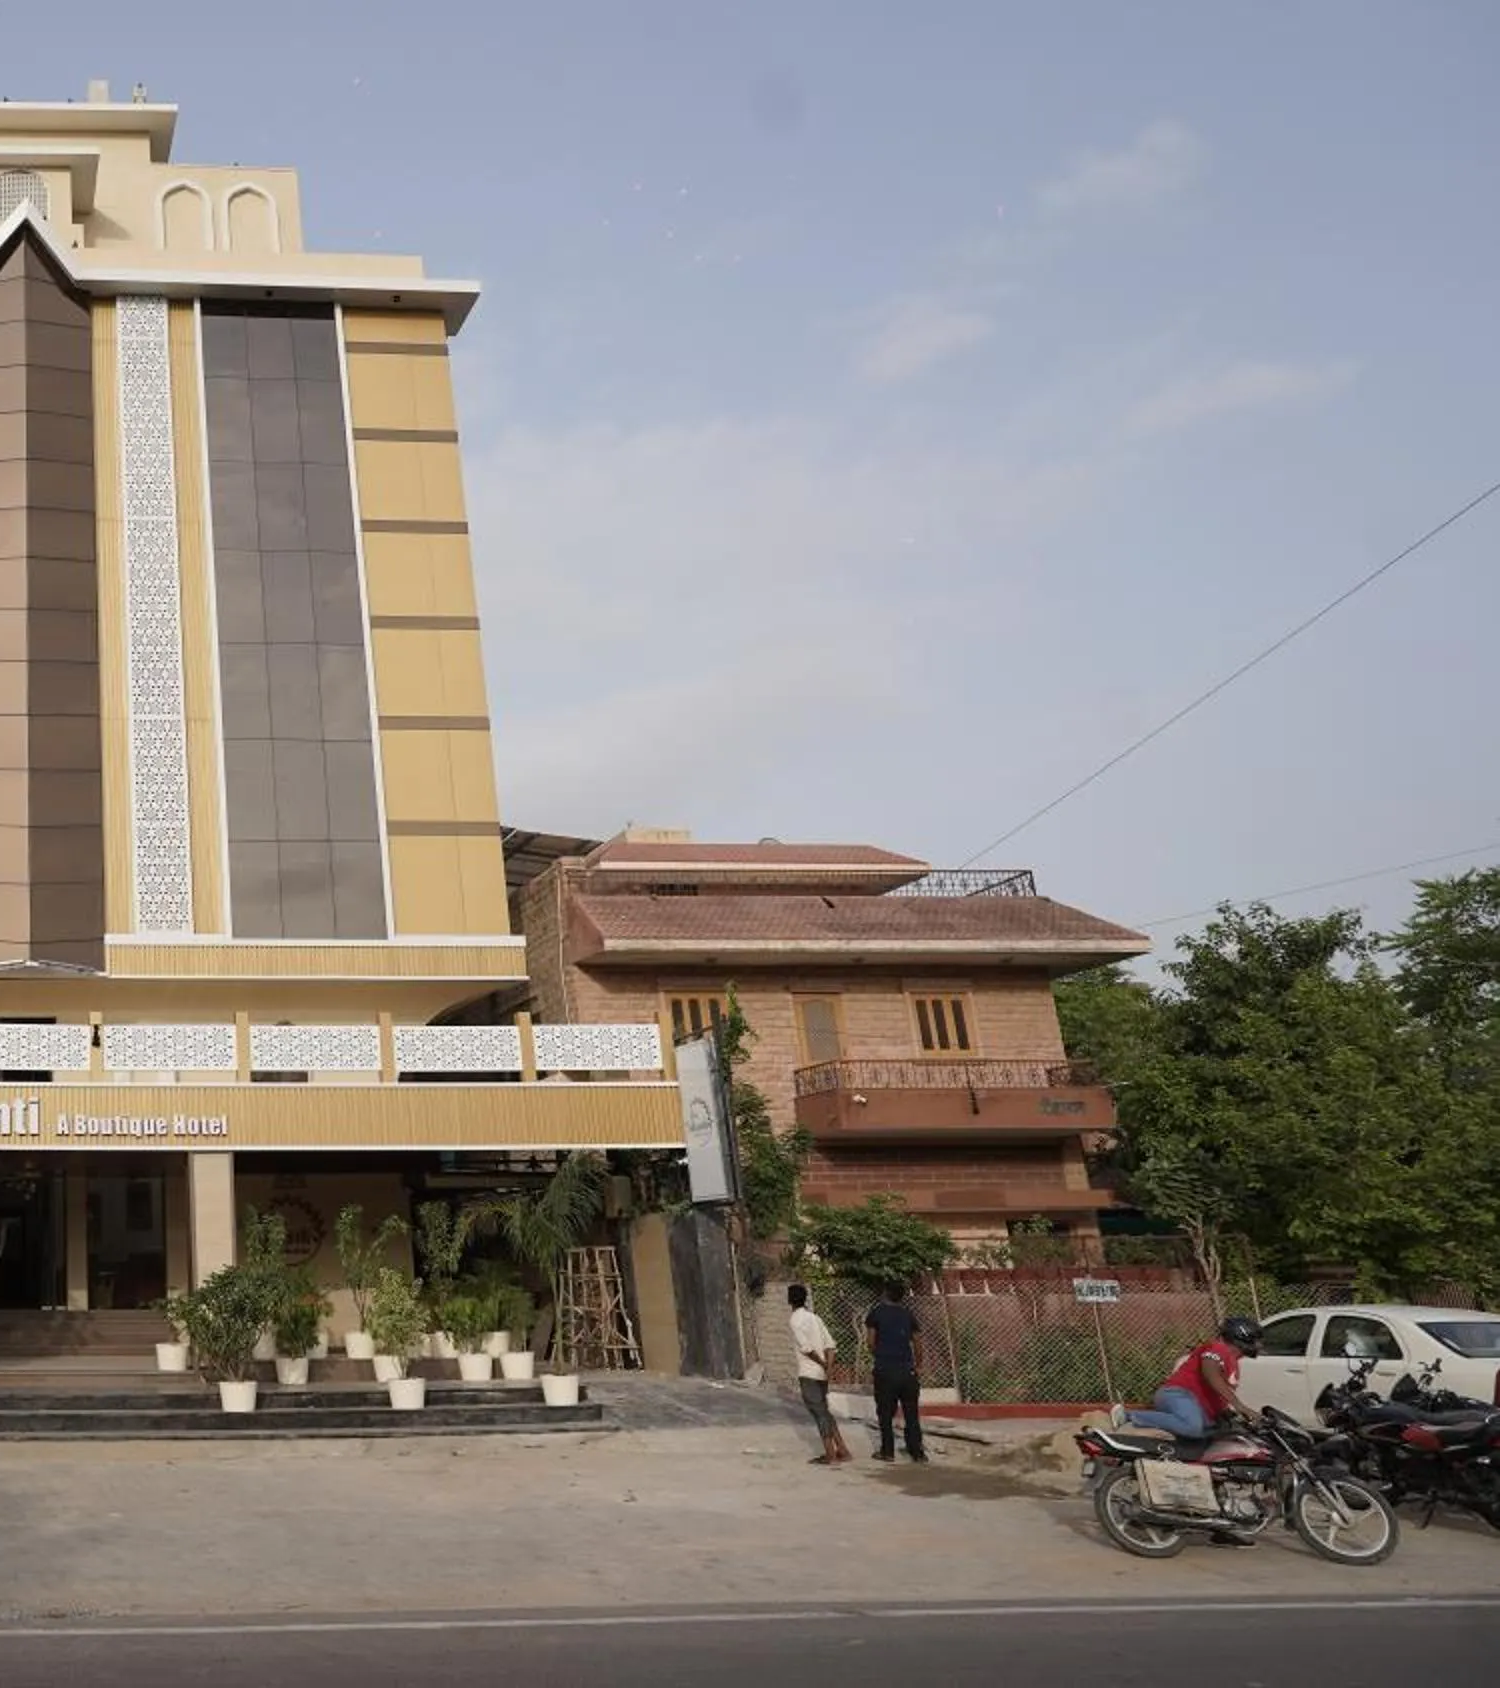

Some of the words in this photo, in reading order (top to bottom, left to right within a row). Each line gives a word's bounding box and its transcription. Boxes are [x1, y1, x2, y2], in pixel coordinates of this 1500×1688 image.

[57, 1114, 70, 1136] A
[74, 1114, 168, 1140] Boutique
[173, 1113, 228, 1136] Hotel
